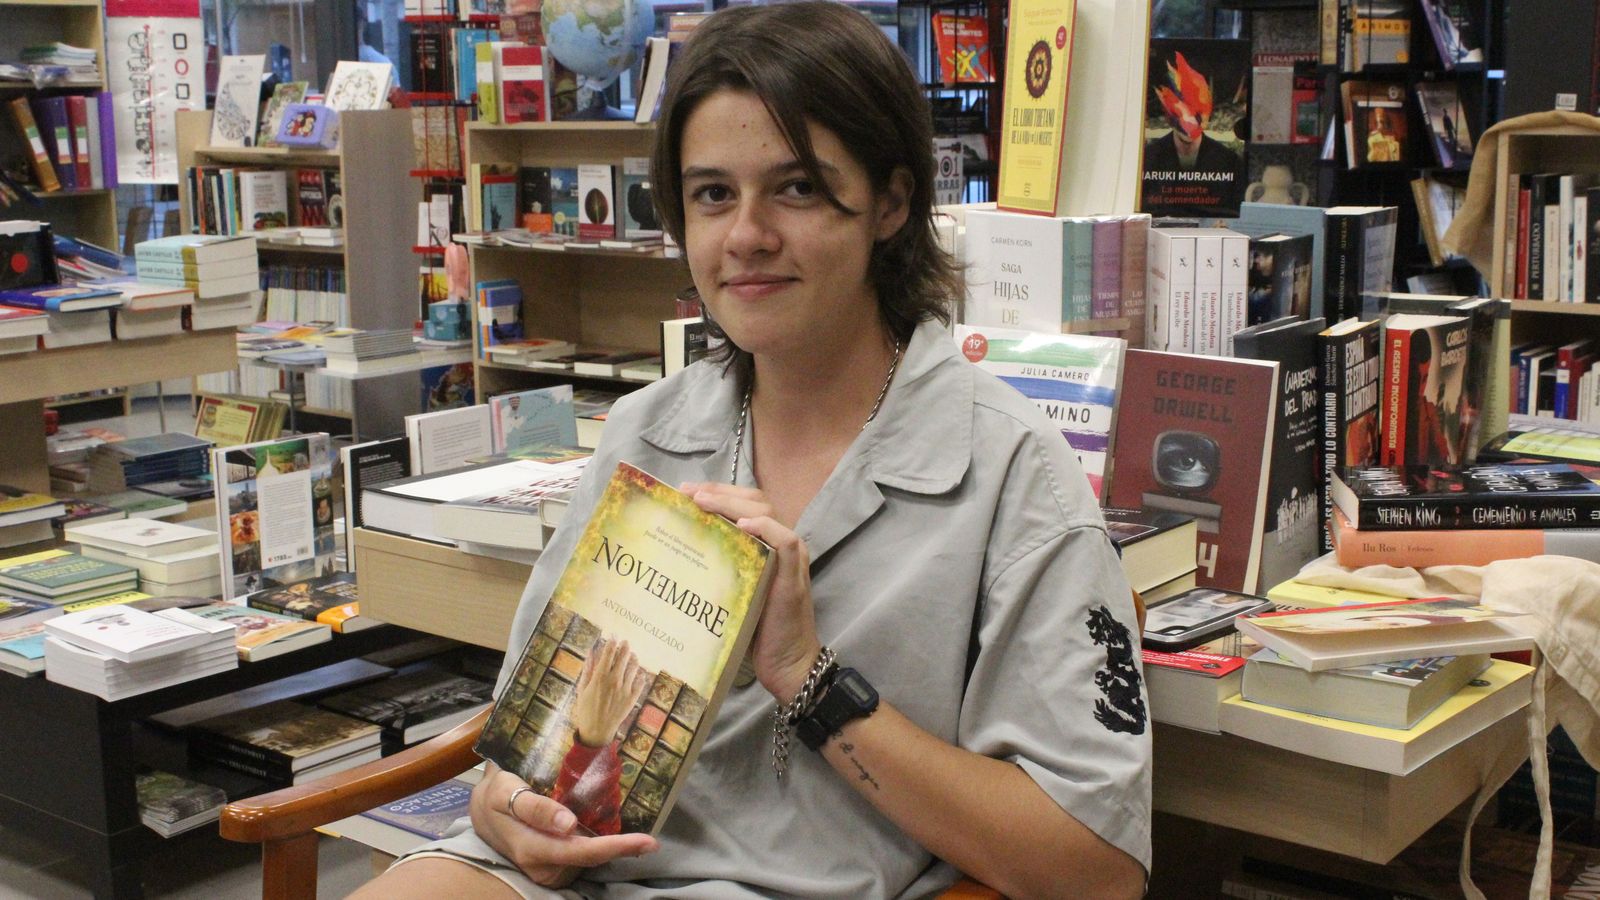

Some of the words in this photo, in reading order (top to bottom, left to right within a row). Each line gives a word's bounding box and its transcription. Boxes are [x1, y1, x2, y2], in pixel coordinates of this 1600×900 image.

[1178, 171, 1234, 181] MURAKAMI
[1174, 185, 1209, 194] muerte
[1164, 195, 1222, 205] comendador
[991, 236, 1015, 246] CARMEN
[1016, 238, 1033, 247] KORN
[1532, 223, 1540, 279] PERTURBADO
[1001, 262, 1022, 274] SAGA
[994, 280, 1029, 301] HIJAS
[1001, 307, 1020, 325] DE
[1021, 367, 1048, 377] JULIA
[1051, 369, 1090, 381] CAMERO
[1391, 348, 1401, 384] ASESINO
[1157, 368, 1237, 396] GEORGE
[1153, 397, 1233, 423] ORWELL
[1284, 397, 1299, 417] DEL
[1325, 392, 1336, 438] CONTRARIO
[1388, 385, 1399, 449] INCONFORMISTA
[1325, 440, 1336, 451] LO
[1376, 506, 1412, 526] STEPHEN
[1415, 502, 1441, 526] KING
[1473, 504, 1527, 524] CEMENTERIO
[1529, 510, 1537, 521] DE
[1540, 507, 1577, 521] ANIMALES
[1363, 543, 1376, 553] Ilu
[1379, 543, 1397, 553] Ros
[602, 598, 645, 627] ANTONIO
[643, 621, 685, 652] CALZADO
[390, 786, 464, 811] SANTIAGO
[422, 790, 470, 806] CAMINO
[402, 805, 421, 814] DE
